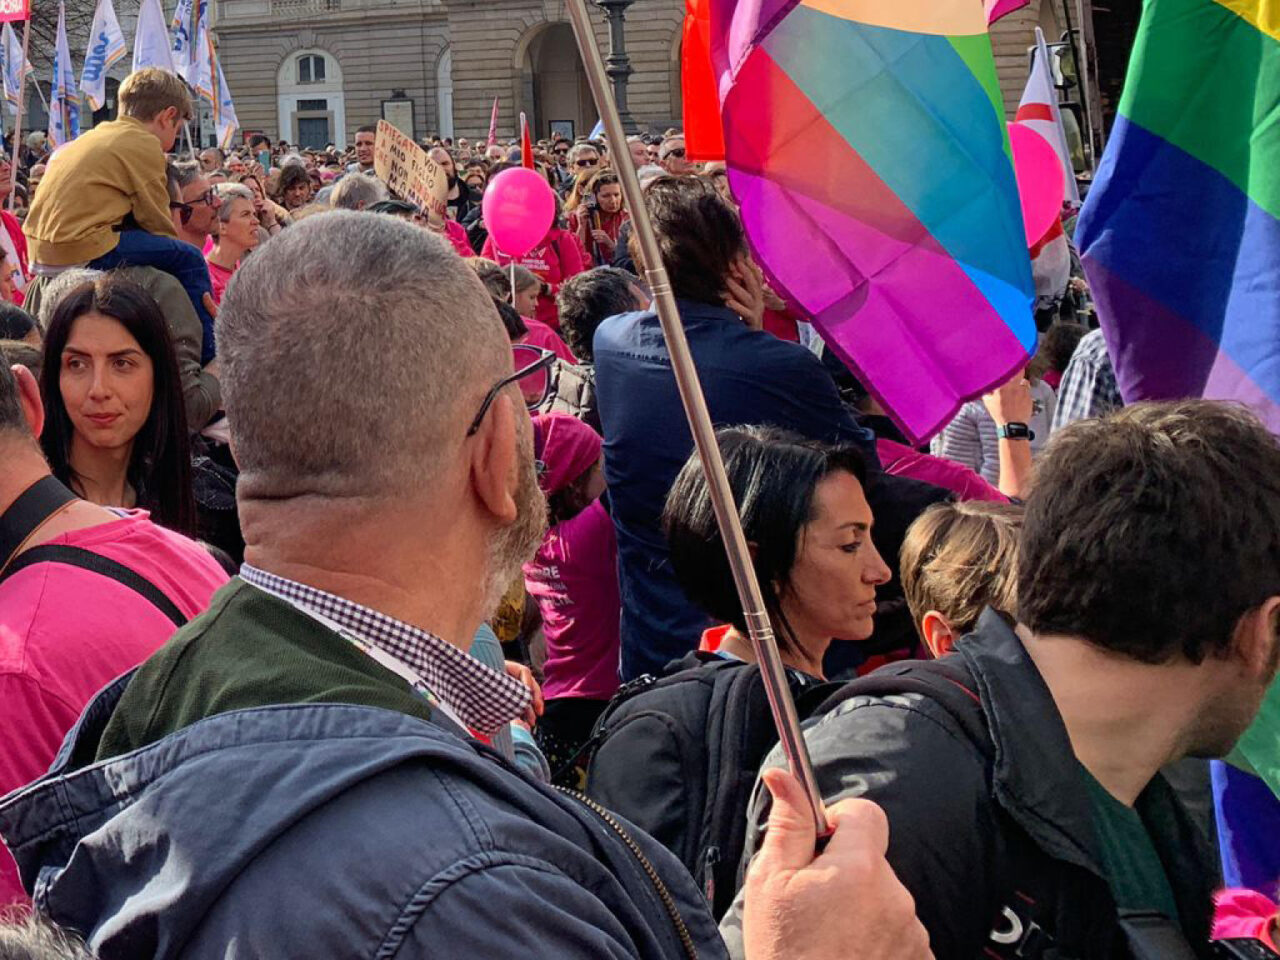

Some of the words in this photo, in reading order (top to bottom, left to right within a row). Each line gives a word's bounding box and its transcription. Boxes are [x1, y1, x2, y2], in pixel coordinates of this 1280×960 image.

[378, 121, 420, 159] SPIEGATE
[424, 156, 438, 178] VOI
[389, 143, 406, 163] MIO
[390, 159, 409, 180] NON
